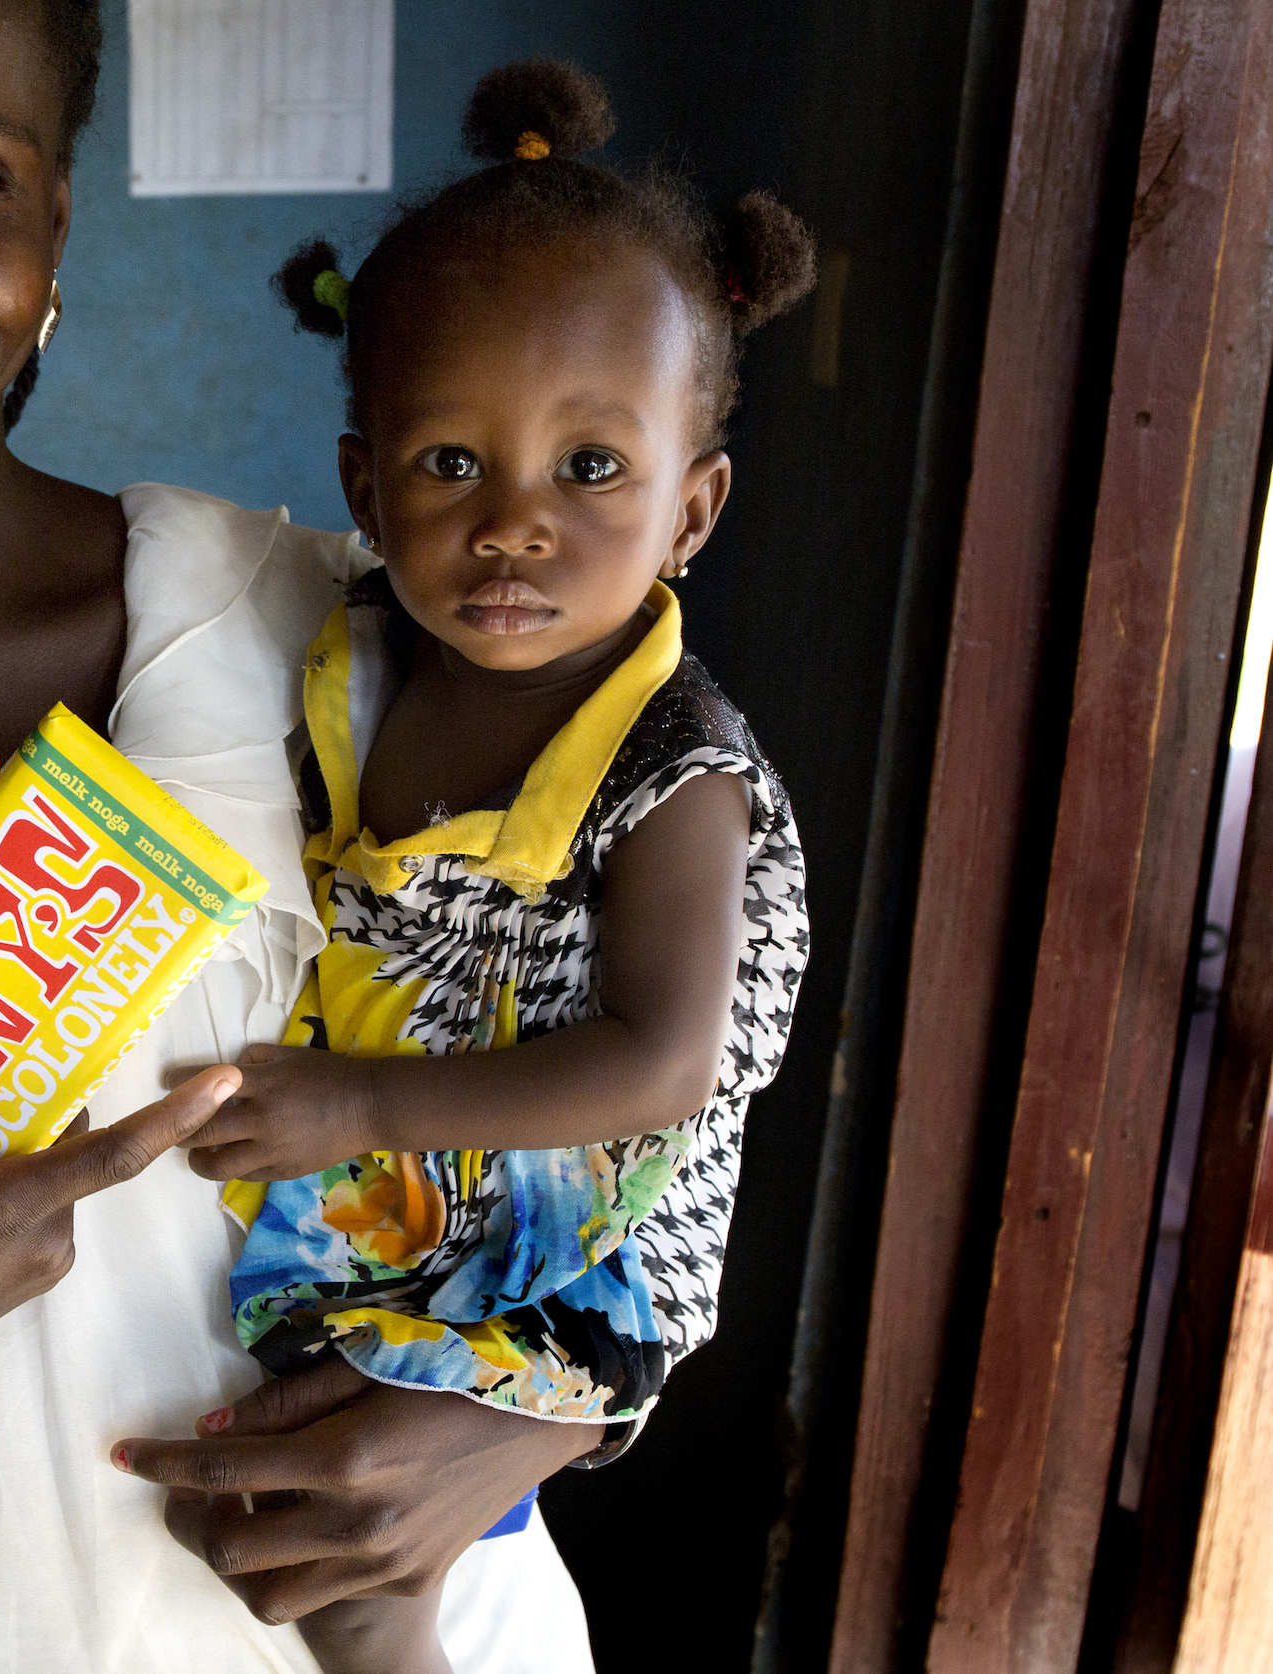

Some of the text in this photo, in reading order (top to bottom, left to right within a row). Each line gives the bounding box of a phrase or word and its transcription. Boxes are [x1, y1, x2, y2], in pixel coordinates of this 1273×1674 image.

[42, 758, 89, 801] melk
[88, 796, 130, 836] noga
[135, 835, 183, 879] melk
[181, 874, 224, 913] noga
